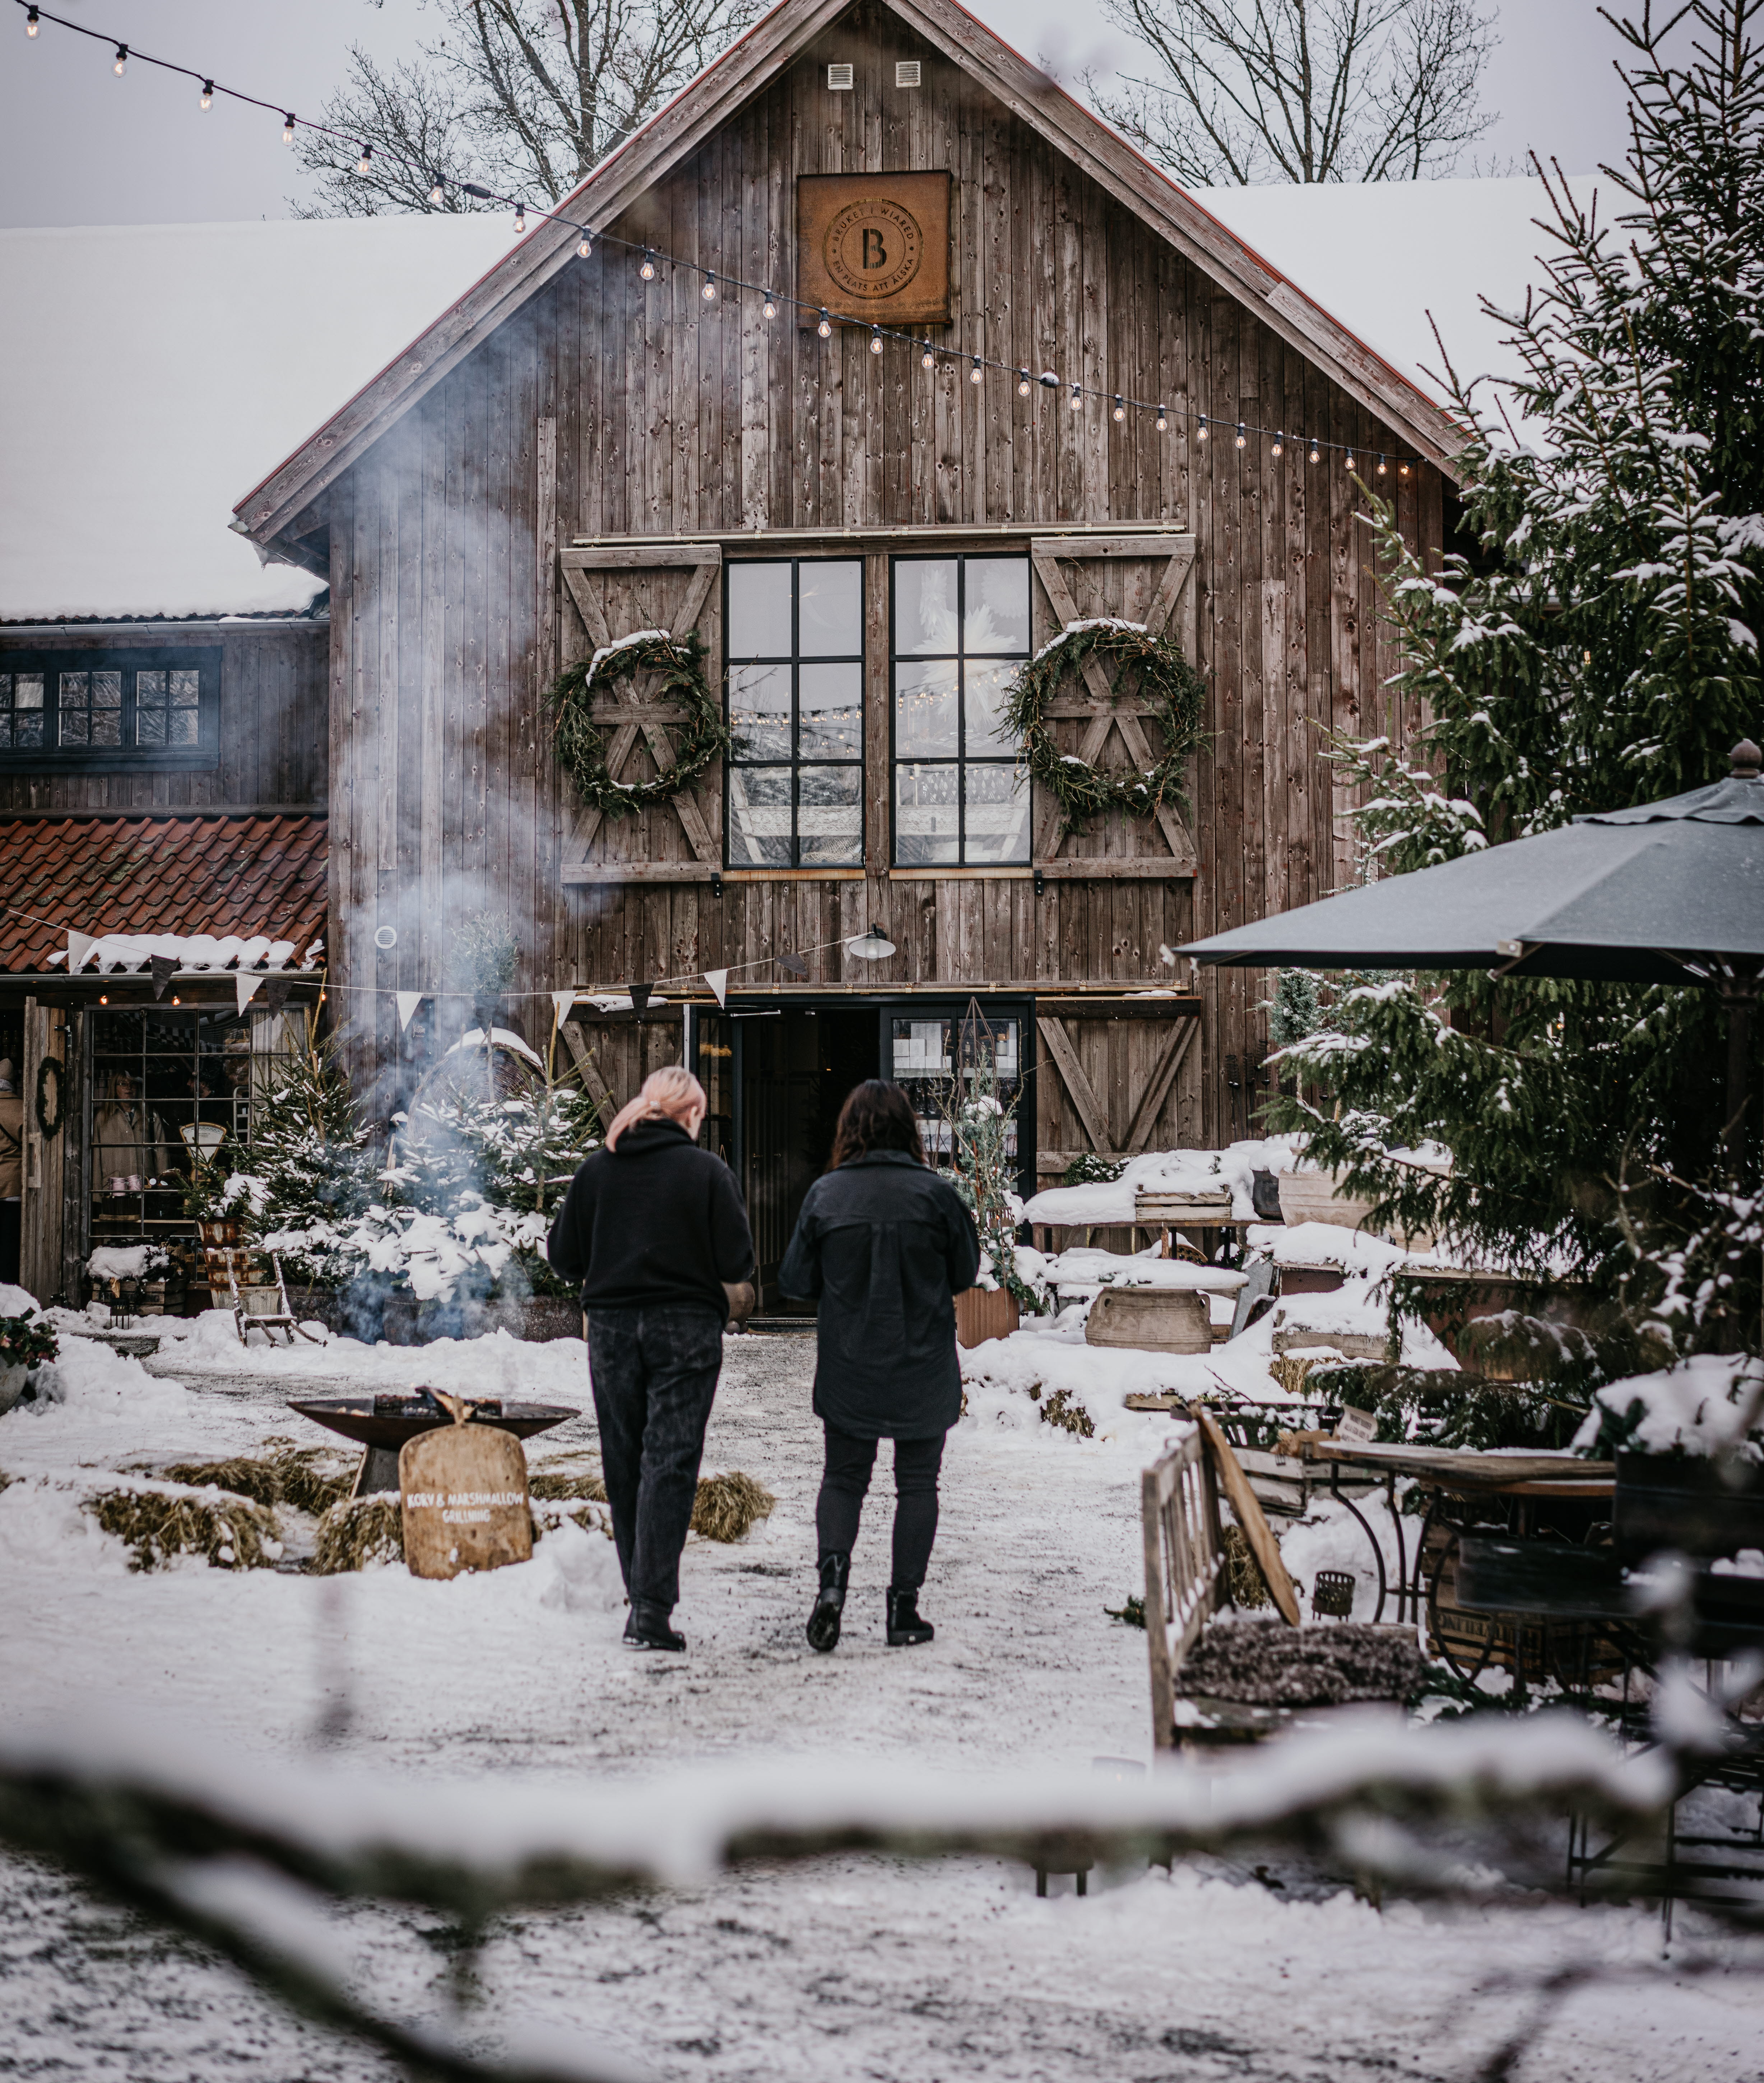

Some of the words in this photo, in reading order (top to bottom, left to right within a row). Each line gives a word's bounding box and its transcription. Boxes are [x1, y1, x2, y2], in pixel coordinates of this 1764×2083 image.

[833, 208, 863, 242] BRUKET
[881, 207, 914, 240] WIARED
[863, 228, 887, 269] B
[833, 261, 842, 274] EN
[842, 275, 868, 292] PLATS
[873, 282, 889, 291] ATT
[893, 258, 914, 285] ÄLSKA
[407, 1493, 435, 1509] KORV
[436, 1492, 445, 1508] &
[447, 1492, 524, 1506] MARSHMALLOW
